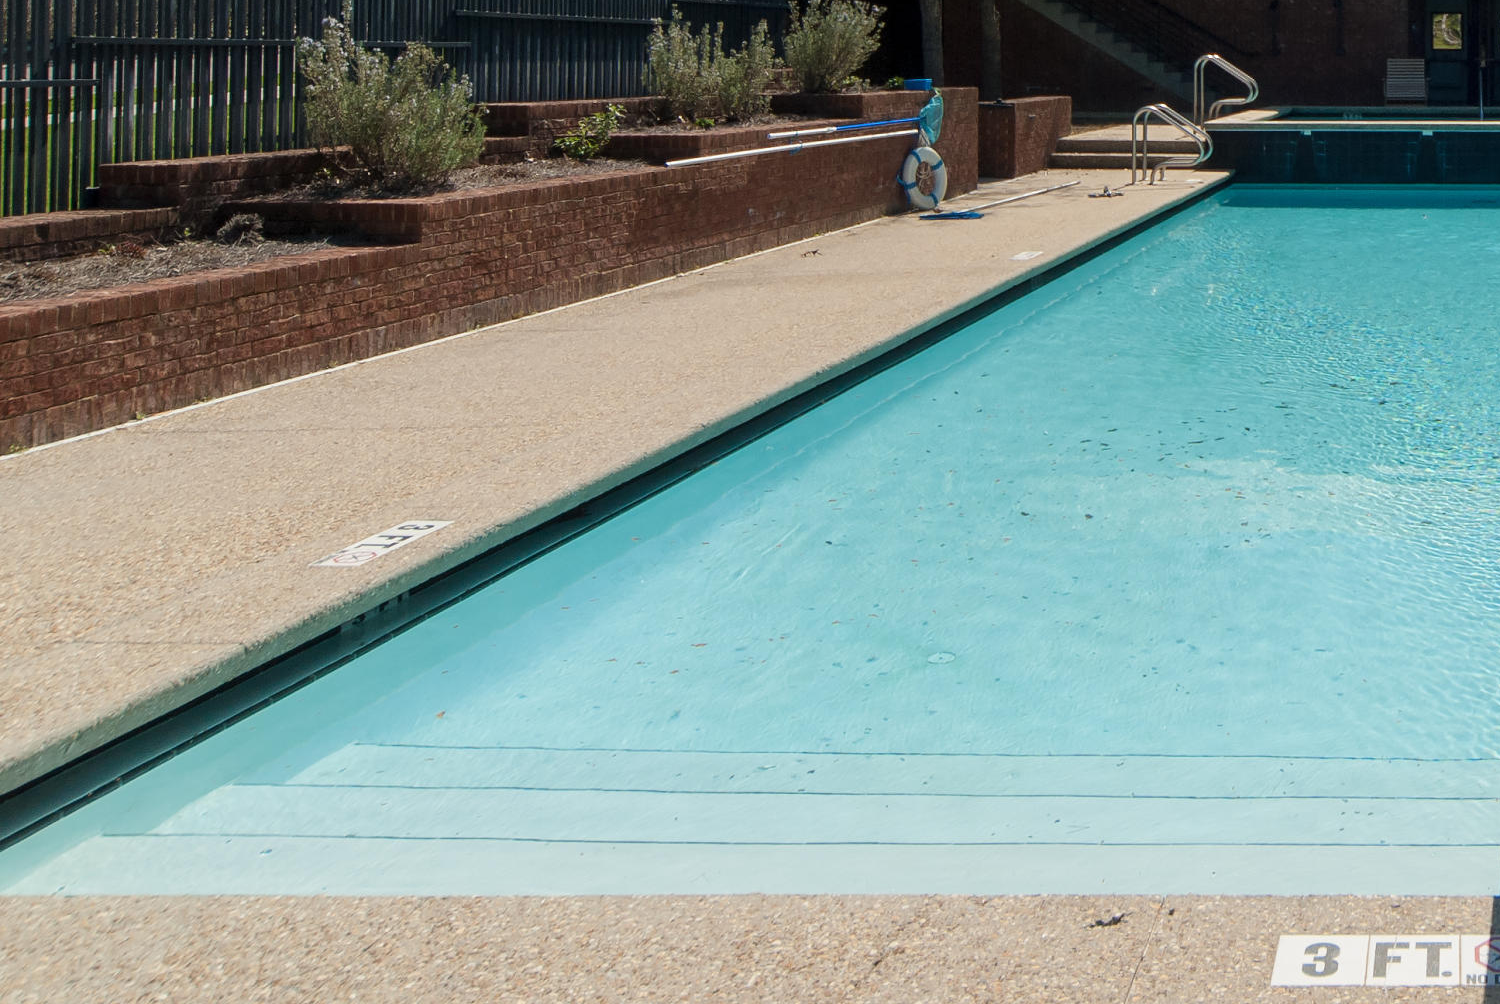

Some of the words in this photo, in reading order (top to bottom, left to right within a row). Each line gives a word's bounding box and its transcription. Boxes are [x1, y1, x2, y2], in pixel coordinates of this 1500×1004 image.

[1301, 942, 1341, 978] 3
[1372, 941, 1453, 978] FT.
[1466, 974, 1488, 985] NO
